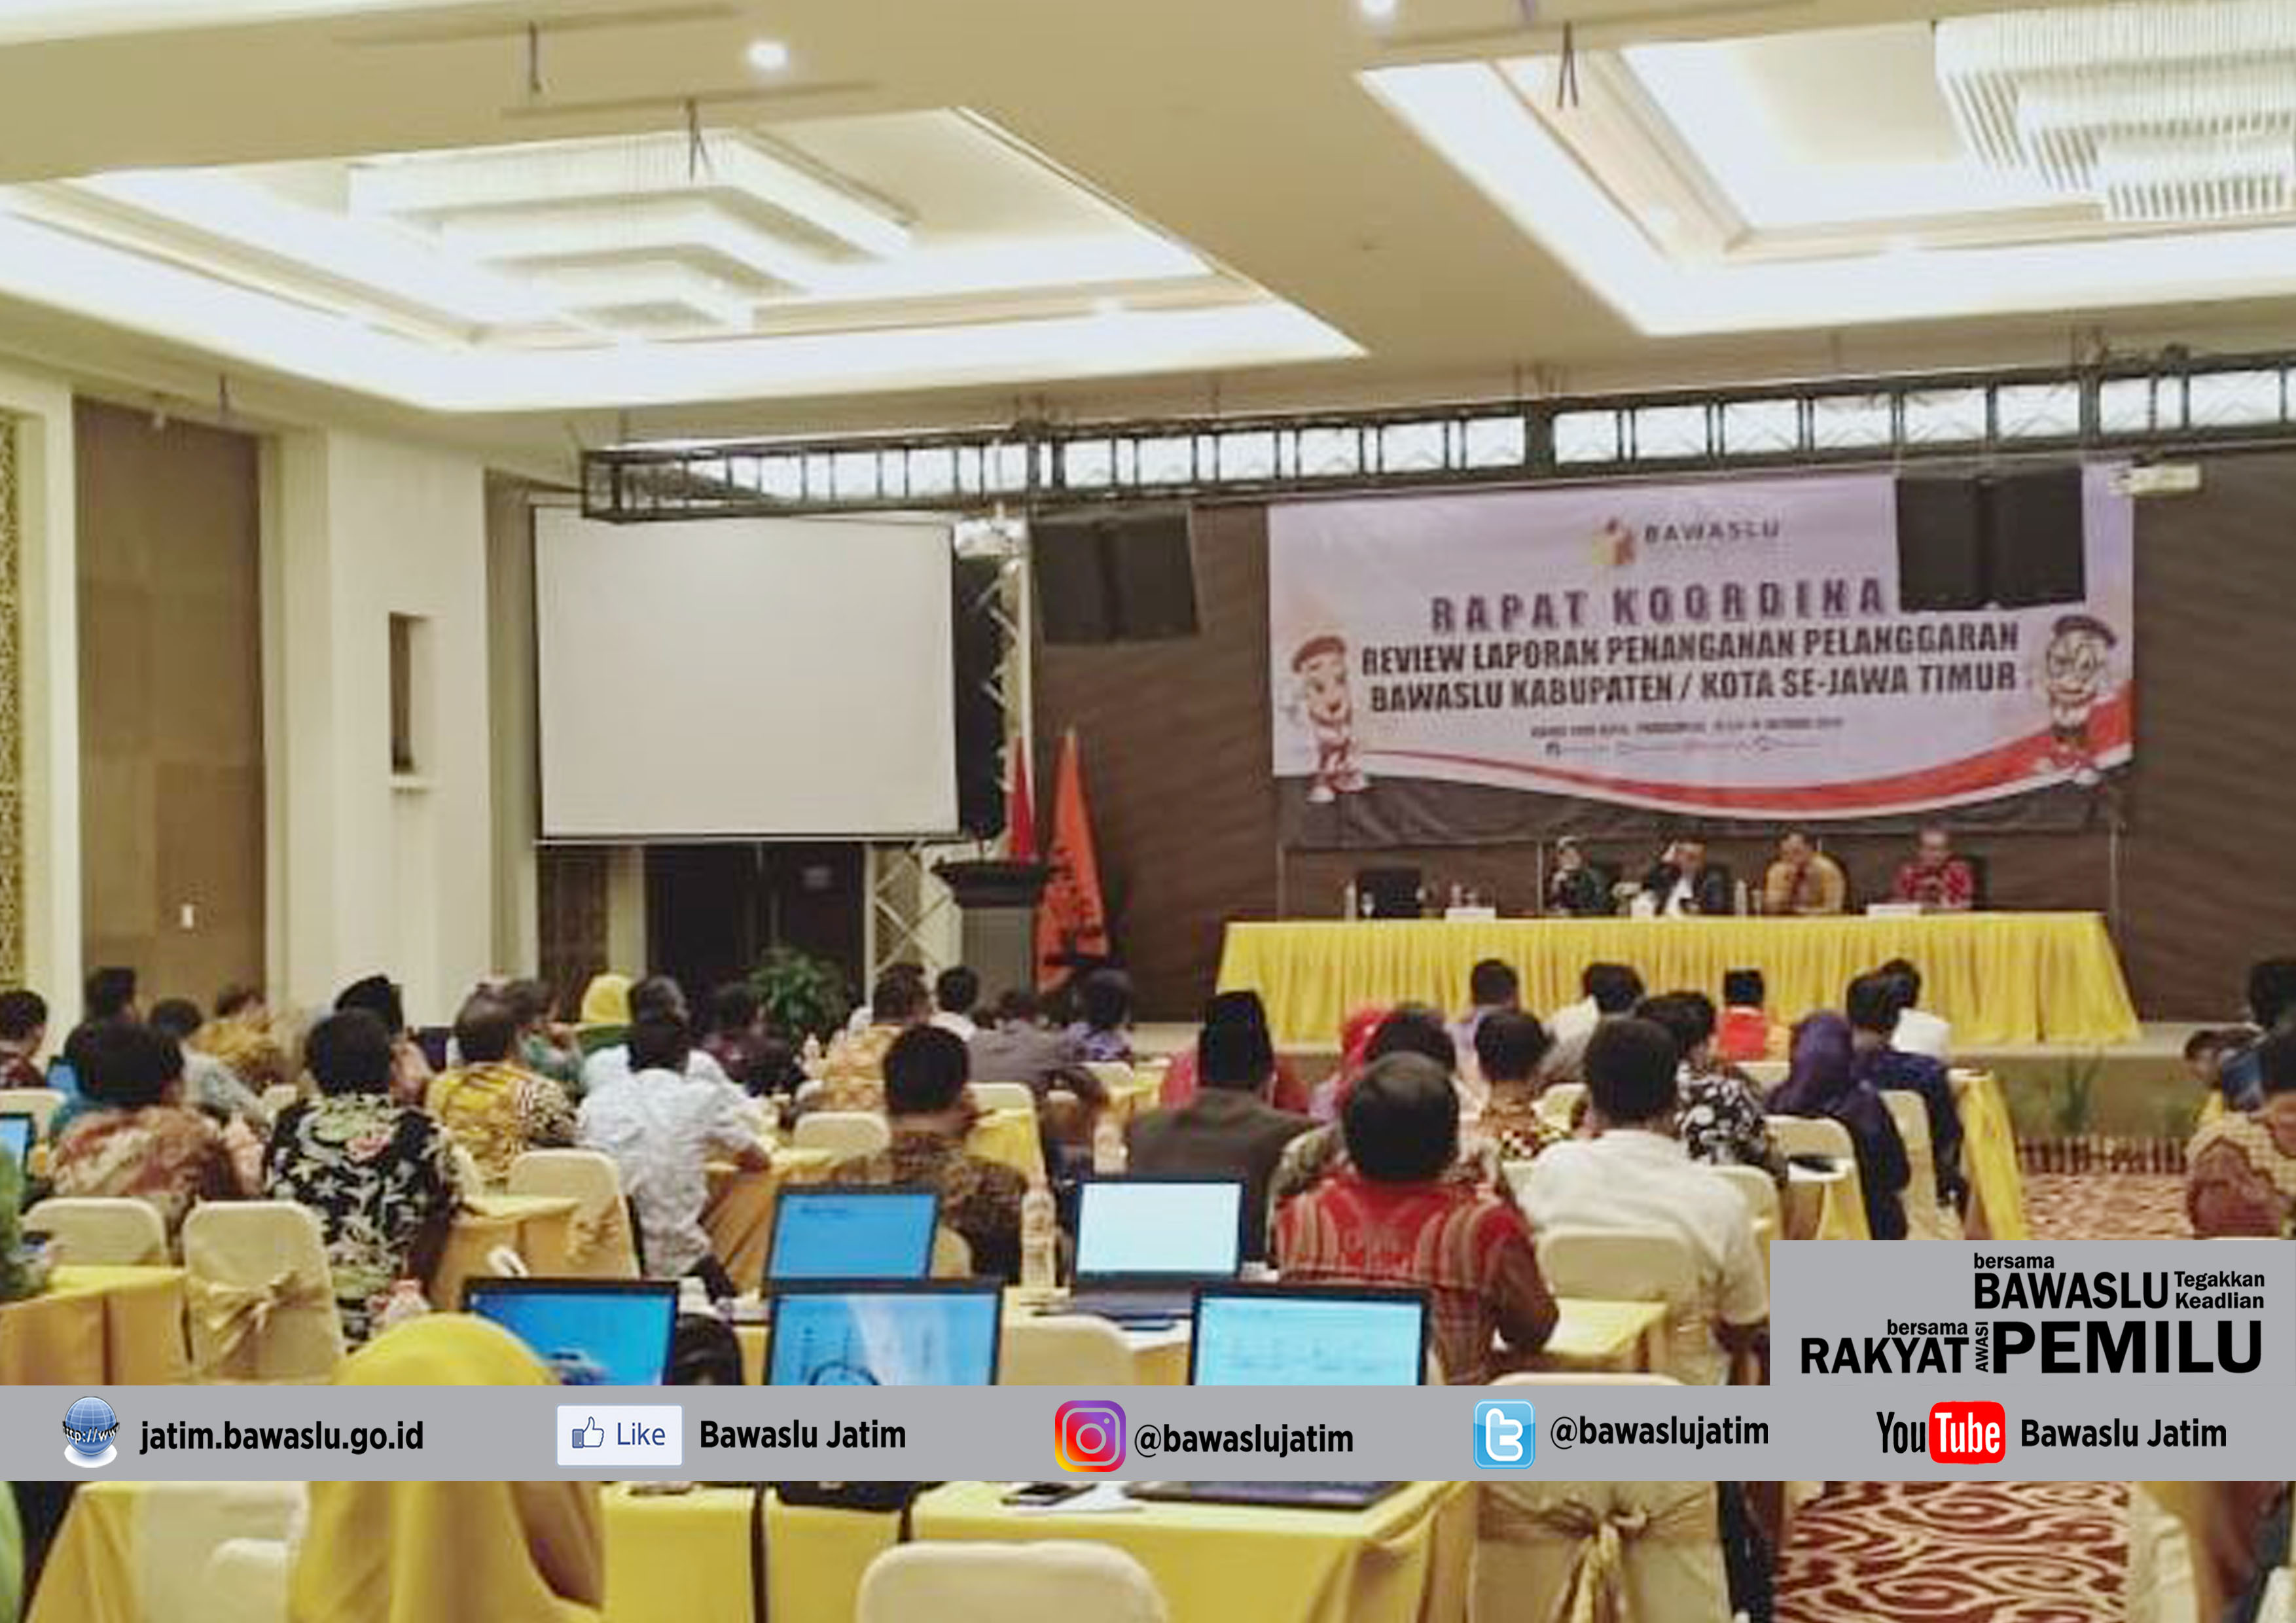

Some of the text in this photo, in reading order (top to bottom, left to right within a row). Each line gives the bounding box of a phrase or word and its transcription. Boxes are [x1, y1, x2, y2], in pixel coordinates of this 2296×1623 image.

[1644, 521, 1780, 543] BAWASLU
[1431, 577, 1882, 633] RAPAT KOORDINA
[1361, 621, 2019, 675] REVIEW LAPORAN PENANGANAN PELANGGARAN
[1372, 680, 1503, 713] BAWASLU
[1511, 674, 1672, 708] KABUPATEN
[1701, 669, 1776, 700] KOTA
[1782, 664, 1909, 698] SE-JAWA
[1918, 660, 2017, 693] TIMUR
